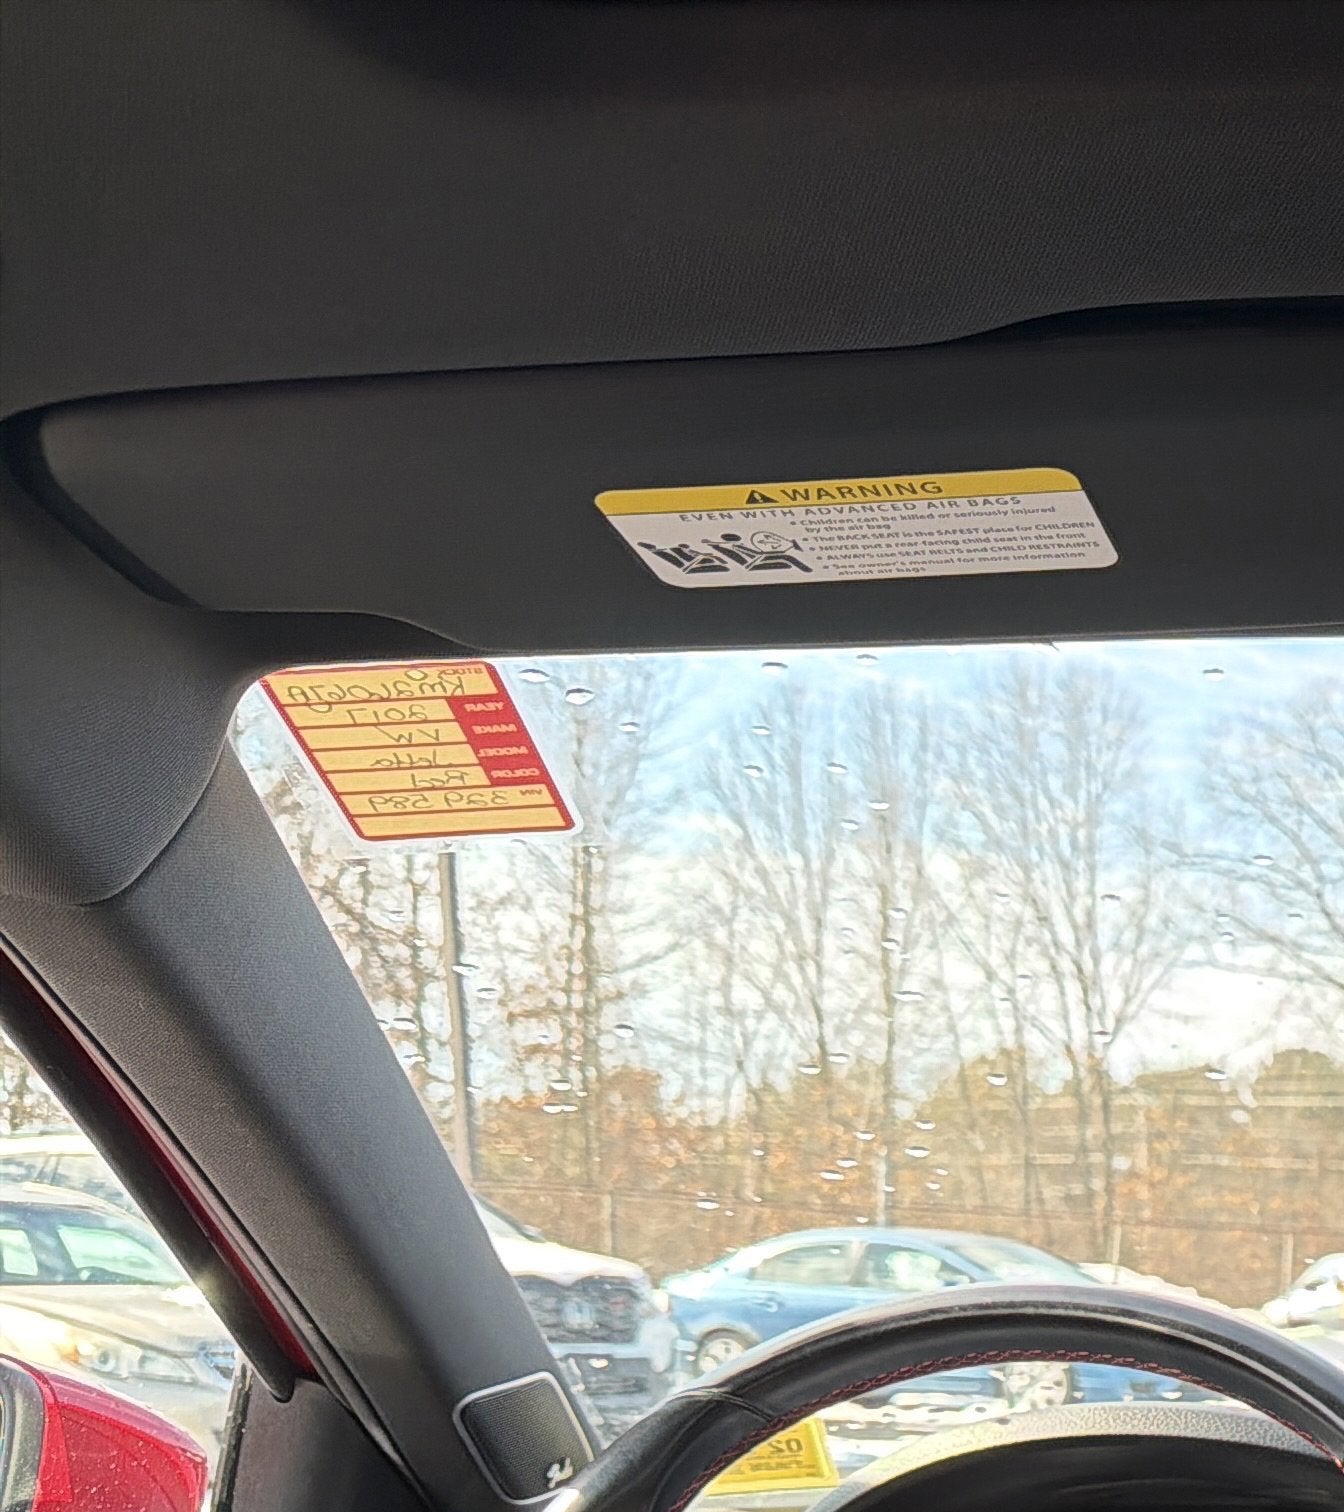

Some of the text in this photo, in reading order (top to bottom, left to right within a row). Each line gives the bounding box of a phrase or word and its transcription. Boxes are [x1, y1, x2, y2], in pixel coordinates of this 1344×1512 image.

[779, 481, 944, 503] WARNING
[678, 496, 1022, 523] EVEN WITH ADVANCED AIR BAGS
[799, 517, 855, 526] Children
[899, 513, 935, 521] killed
[953, 509, 1009, 519] seriously
[1009, 506, 1056, 516] injured
[836, 533, 870, 541] BACK
[935, 528, 981, 536] SAFEST
[982, 526, 1015, 534] place
[1033, 522, 1096, 531] CHILDREN
[865, 523, 892, 531] bag
